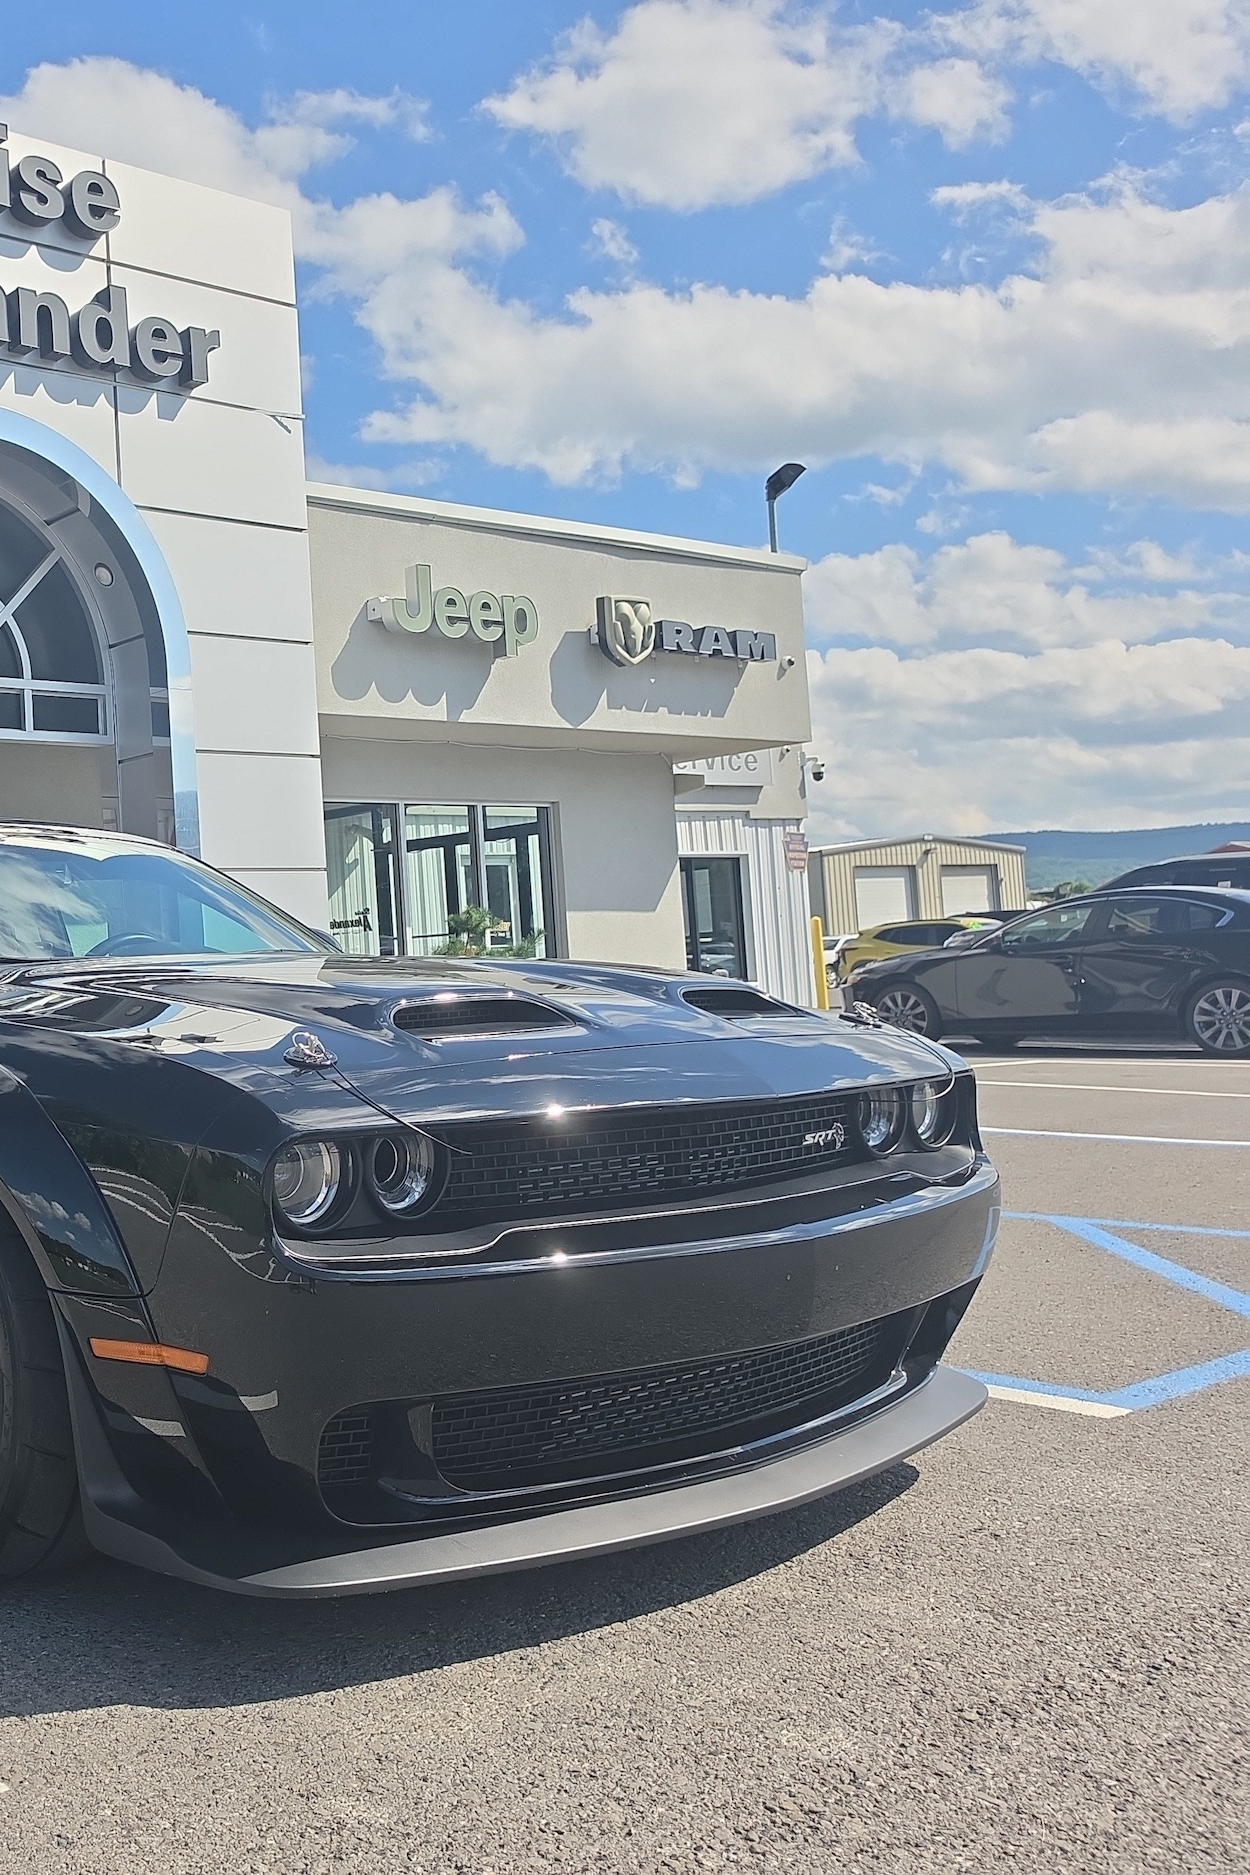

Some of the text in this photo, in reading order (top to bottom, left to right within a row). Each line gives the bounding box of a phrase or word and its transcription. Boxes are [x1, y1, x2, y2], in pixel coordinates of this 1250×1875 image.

[389, 564, 538, 657] Jeep
[658, 620, 777, 661] RAM
[802, 1129, 837, 1146] SRT
